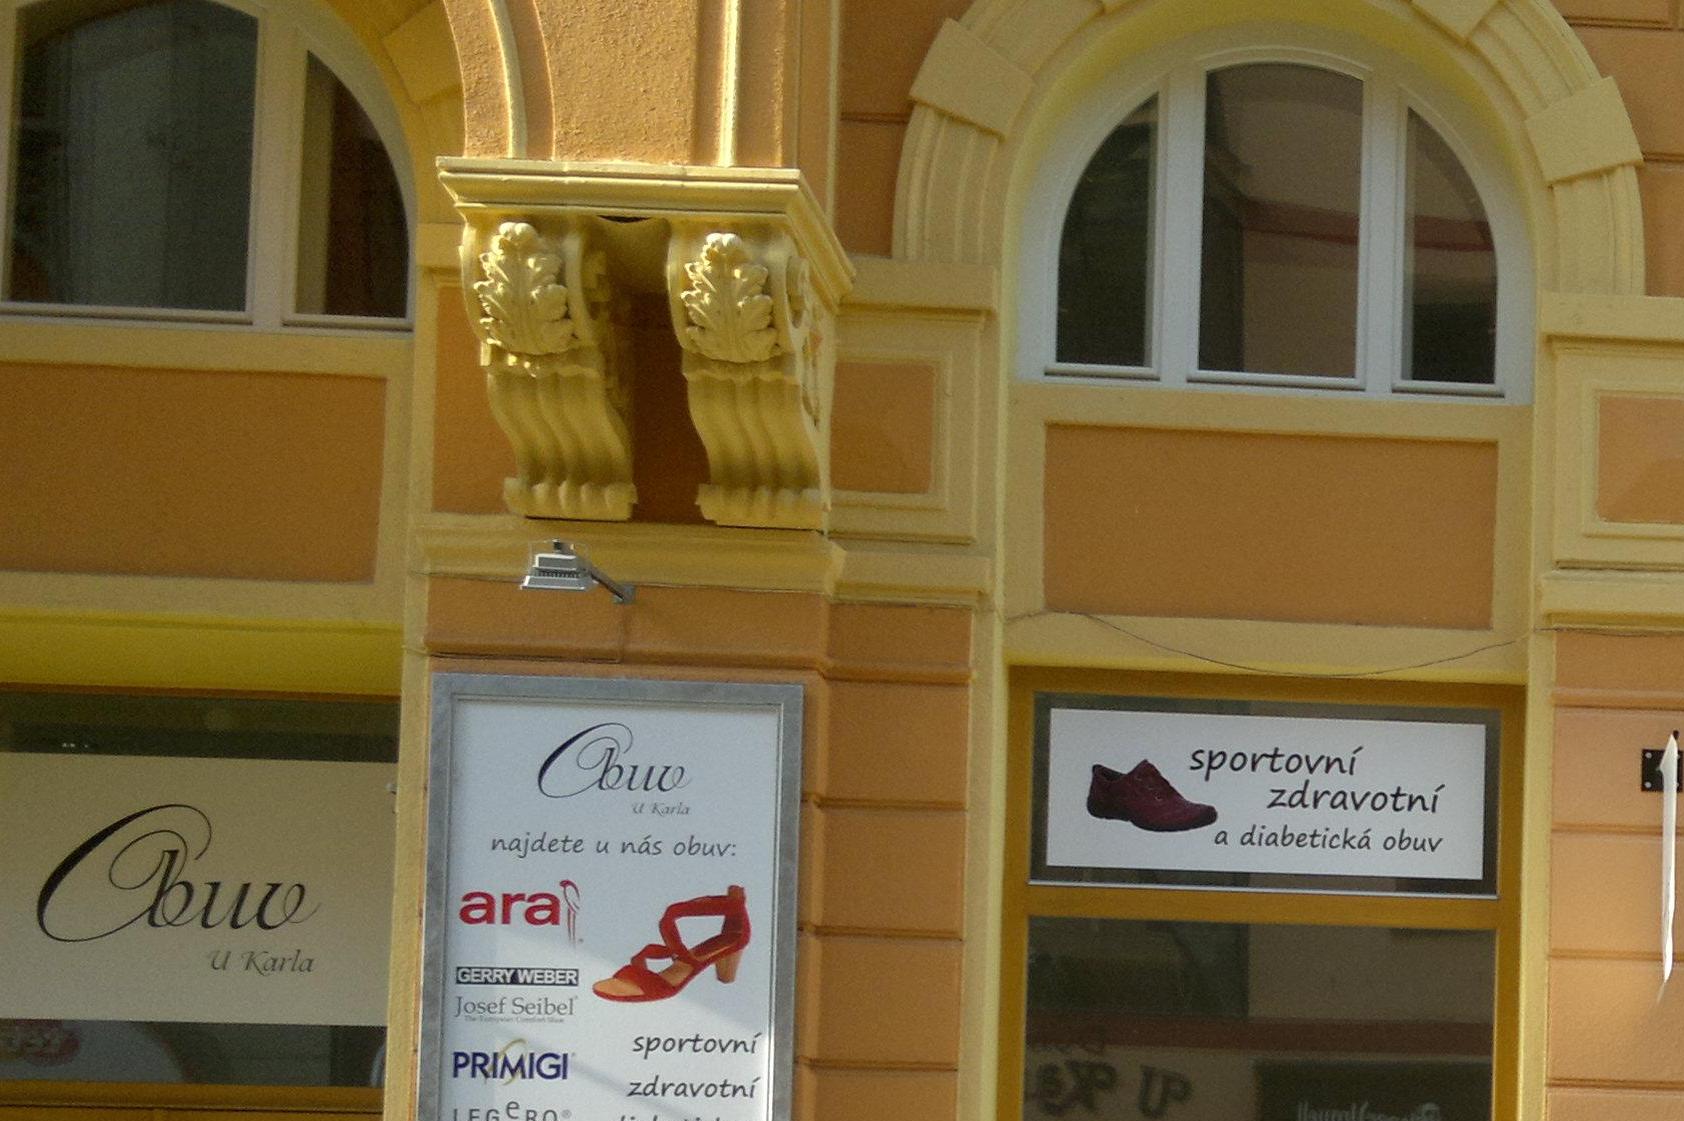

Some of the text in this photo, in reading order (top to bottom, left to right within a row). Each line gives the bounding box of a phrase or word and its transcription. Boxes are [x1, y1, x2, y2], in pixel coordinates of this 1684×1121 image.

[1189, 746, 1364, 781] sportovní
[651, 801, 691, 817] Karla
[1266, 780, 1446, 814] zdravotní
[491, 832, 737, 859] najdete u nás obuv:
[1214, 824, 1444, 853] a diabetická obuv
[458, 891, 561, 926] ara
[208, 949, 317, 977] U Karla
[458, 968, 578, 985] GERRY WEBER
[454, 996, 574, 1018] Josef Seibel
[632, 1032, 762, 1060] sportovní
[452, 1051, 568, 1080] PRIMIGI
[627, 1075, 760, 1099] zdravotní
